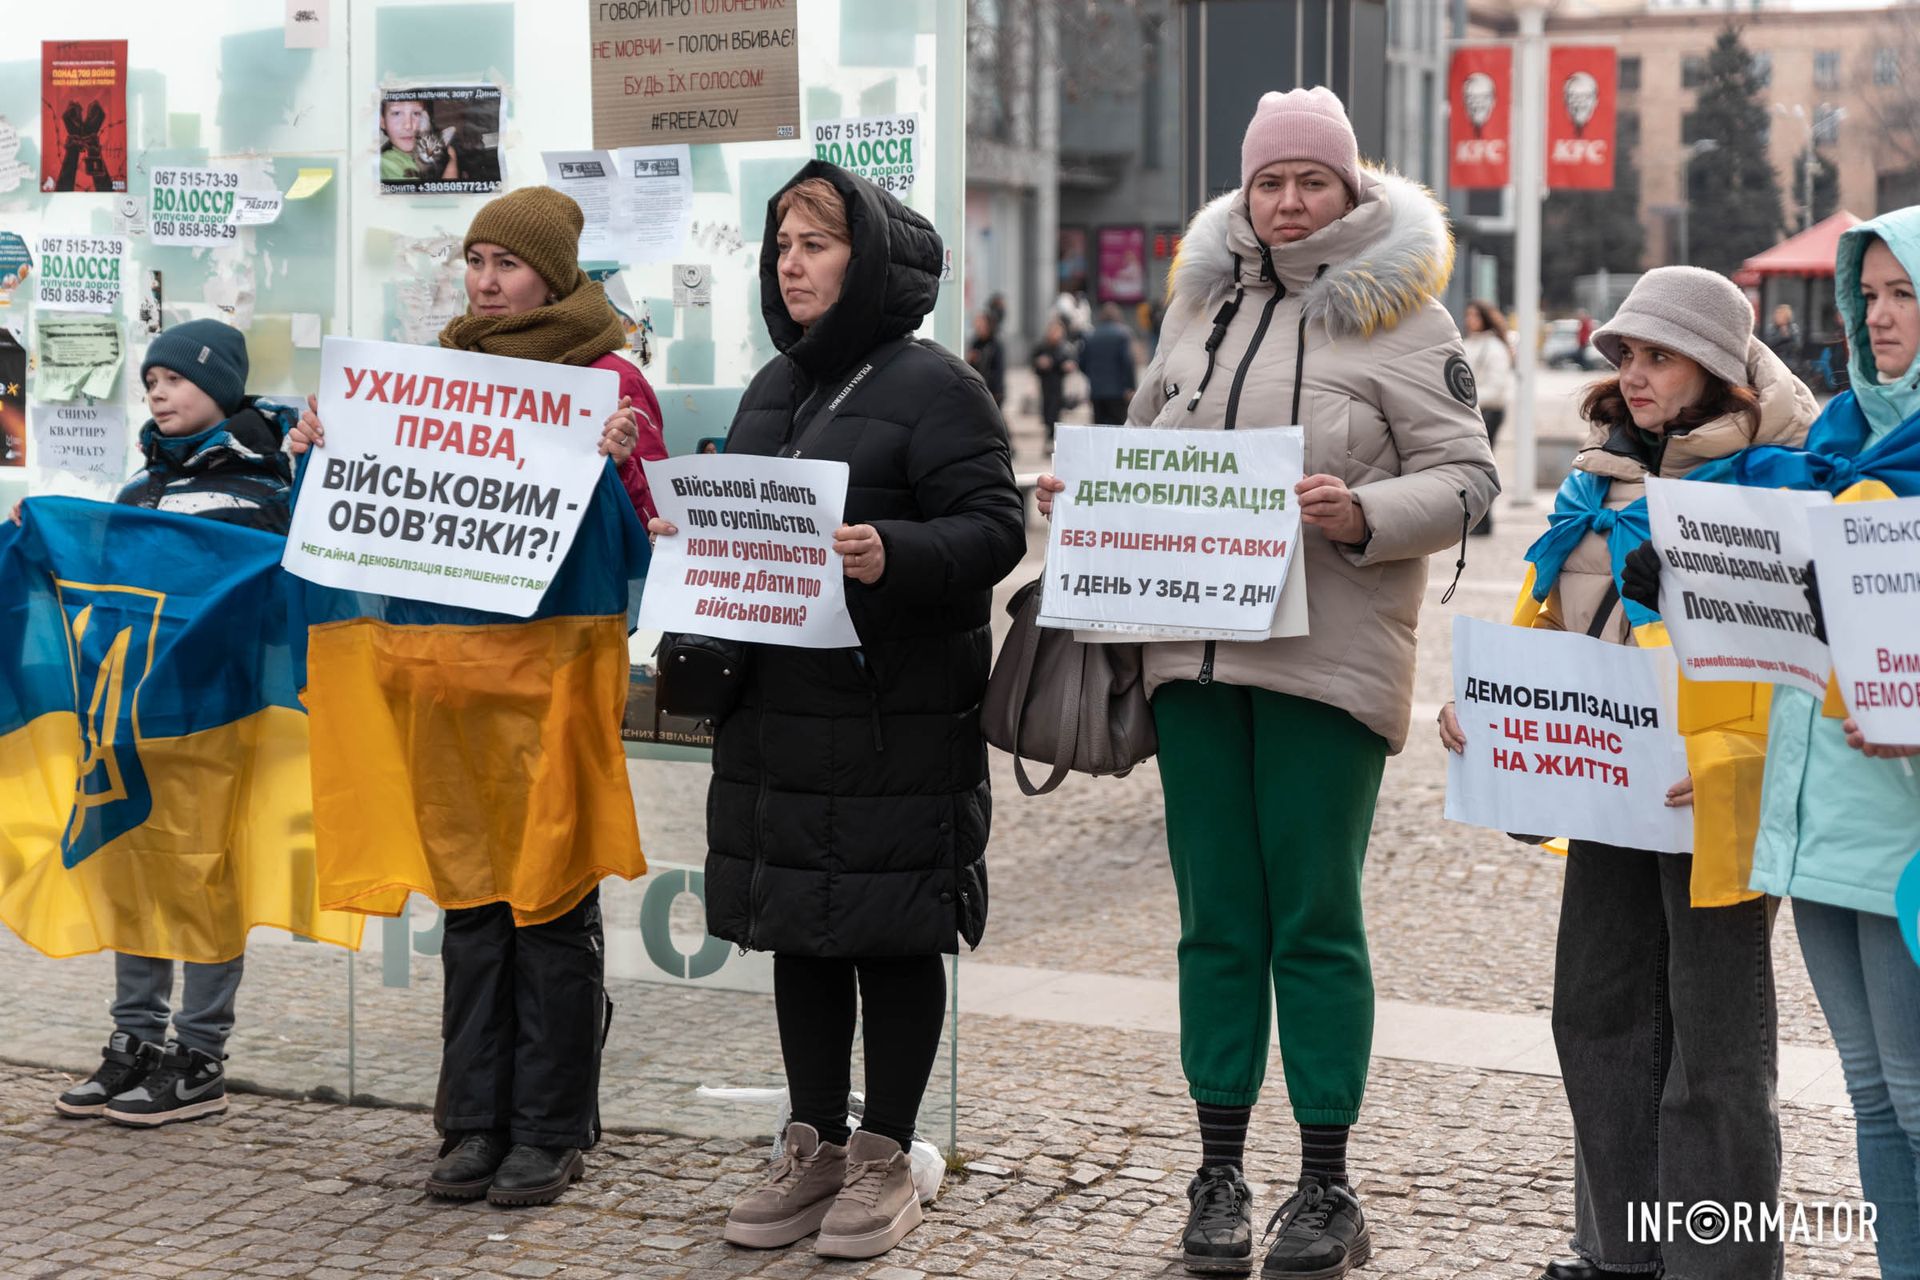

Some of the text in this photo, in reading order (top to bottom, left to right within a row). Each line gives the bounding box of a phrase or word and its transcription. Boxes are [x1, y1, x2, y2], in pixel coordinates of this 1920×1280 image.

[600, 0, 657, 21] ГОВОРИ
[661, 0, 691, 16] ПРО
[592, 41, 611, 59] НЕ
[615, 38, 662, 58] МОВЧИ
[678, 33, 729, 54] ПОЛОН
[731, 28, 796, 51] ВБИВАЄ!
[624, 68, 764, 97] БУДЬ ЇХ ГОЛОСОМ!
[651, 109, 739, 131] #FREEAZOV
[816, 119, 915, 141] 067 515-73-39
[815, 137, 913, 167] ВОЛОССЯ
[1456, 140, 1506, 164] KFC
[1552, 138, 1608, 166] KFC
[155, 171, 238, 188] 067 515-73-39
[870, 164, 913, 178] дорого
[153, 187, 235, 214] ВОЛОССЯ
[244, 199, 279, 210] РАБОТА
[154, 221, 175, 236] 050
[179, 222, 237, 239] 858-96-29
[198, 213, 229, 224] дорог
[42, 239, 62, 253] 067
[66, 240, 122, 255] 515-73-39
[41, 254, 120, 281] ВОЛОССЯ
[41, 288, 62, 302] 050
[85, 281, 120, 291] дорого
[343, 367, 571, 427] УХИЛЯНТАМ
[57, 408, 98, 420] СНИМУ
[49, 425, 107, 438] КВАРТИРУ
[395, 415, 526, 470] ПРАВА,
[1115, 445, 1239, 475] НЕГАЙНА
[322, 453, 561, 520] ВІЙСЬКОВИМ
[671, 476, 817, 506] Військові дбають
[1074, 480, 1287, 514] ДЕМОБІЛІЗАЦІЯ
[687, 508, 820, 537] про суспільство,
[1678, 514, 1781, 555] За перемогу
[687, 538, 827, 567] коли суспільство
[1060, 529, 1287, 558] БЕЗ РІШЕННЯ СТАВКИ
[301, 542, 356, 562] НЕГАЙНА
[358, 553, 442, 575] ДЕМОБІЛІЗАЦІЯ
[444, 566, 463, 578] БЕЗ
[463, 568, 510, 585] РІШЕННЯ
[1665, 546, 1790, 585] відповідальні
[684, 568, 821, 598] почне дбати про
[1060, 574, 1277, 606] 1 ДЕНЬ У ЗБД = 2 ДНІ
[1852, 571, 1920, 595] втомл
[695, 596, 807, 628] військових?
[1682, 591, 1817, 638] Пора мінятис
[1465, 676, 1659, 729] ДЕМОБІЛІЗАЦІЯ
[1504, 717, 1539, 744] ЦЕ
[1546, 722, 1624, 754] ШАНС
[1493, 747, 1629, 787] НА ЖИТТЯ
